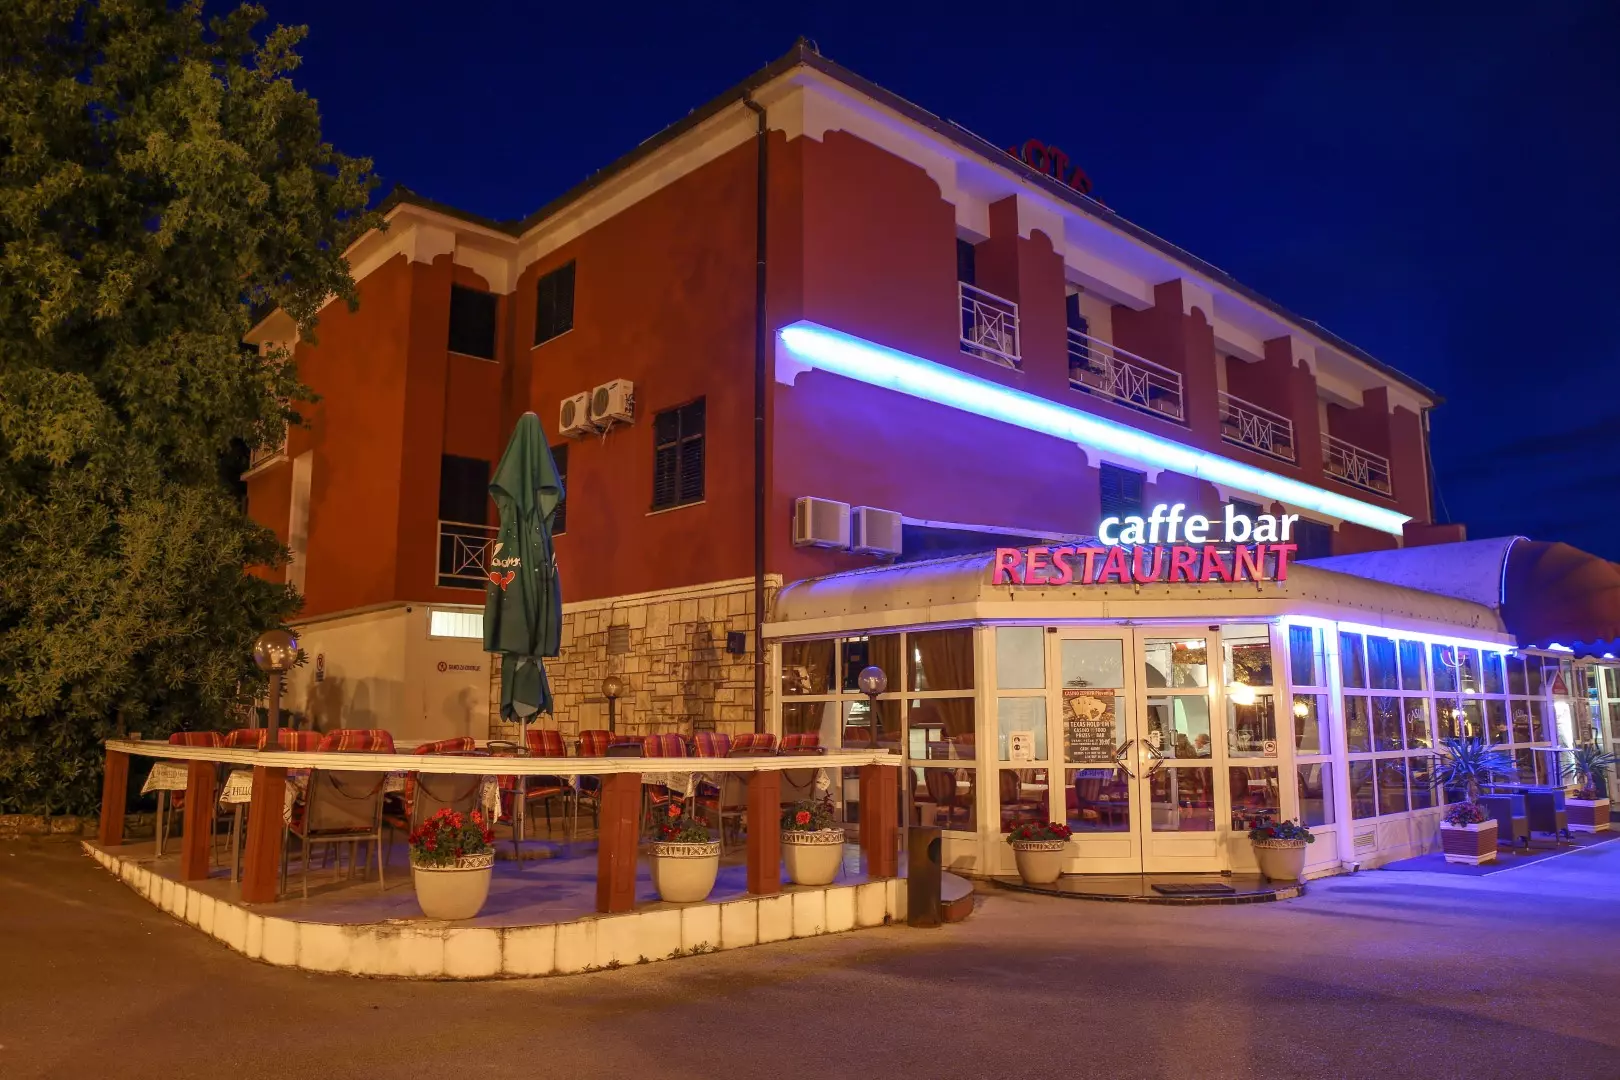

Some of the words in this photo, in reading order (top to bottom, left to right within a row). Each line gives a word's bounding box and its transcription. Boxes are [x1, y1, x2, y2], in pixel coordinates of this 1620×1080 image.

[1098, 503, 1210, 545] caffe
[1224, 503, 1299, 543] bar
[992, 543, 1298, 586] RESTAURANT
